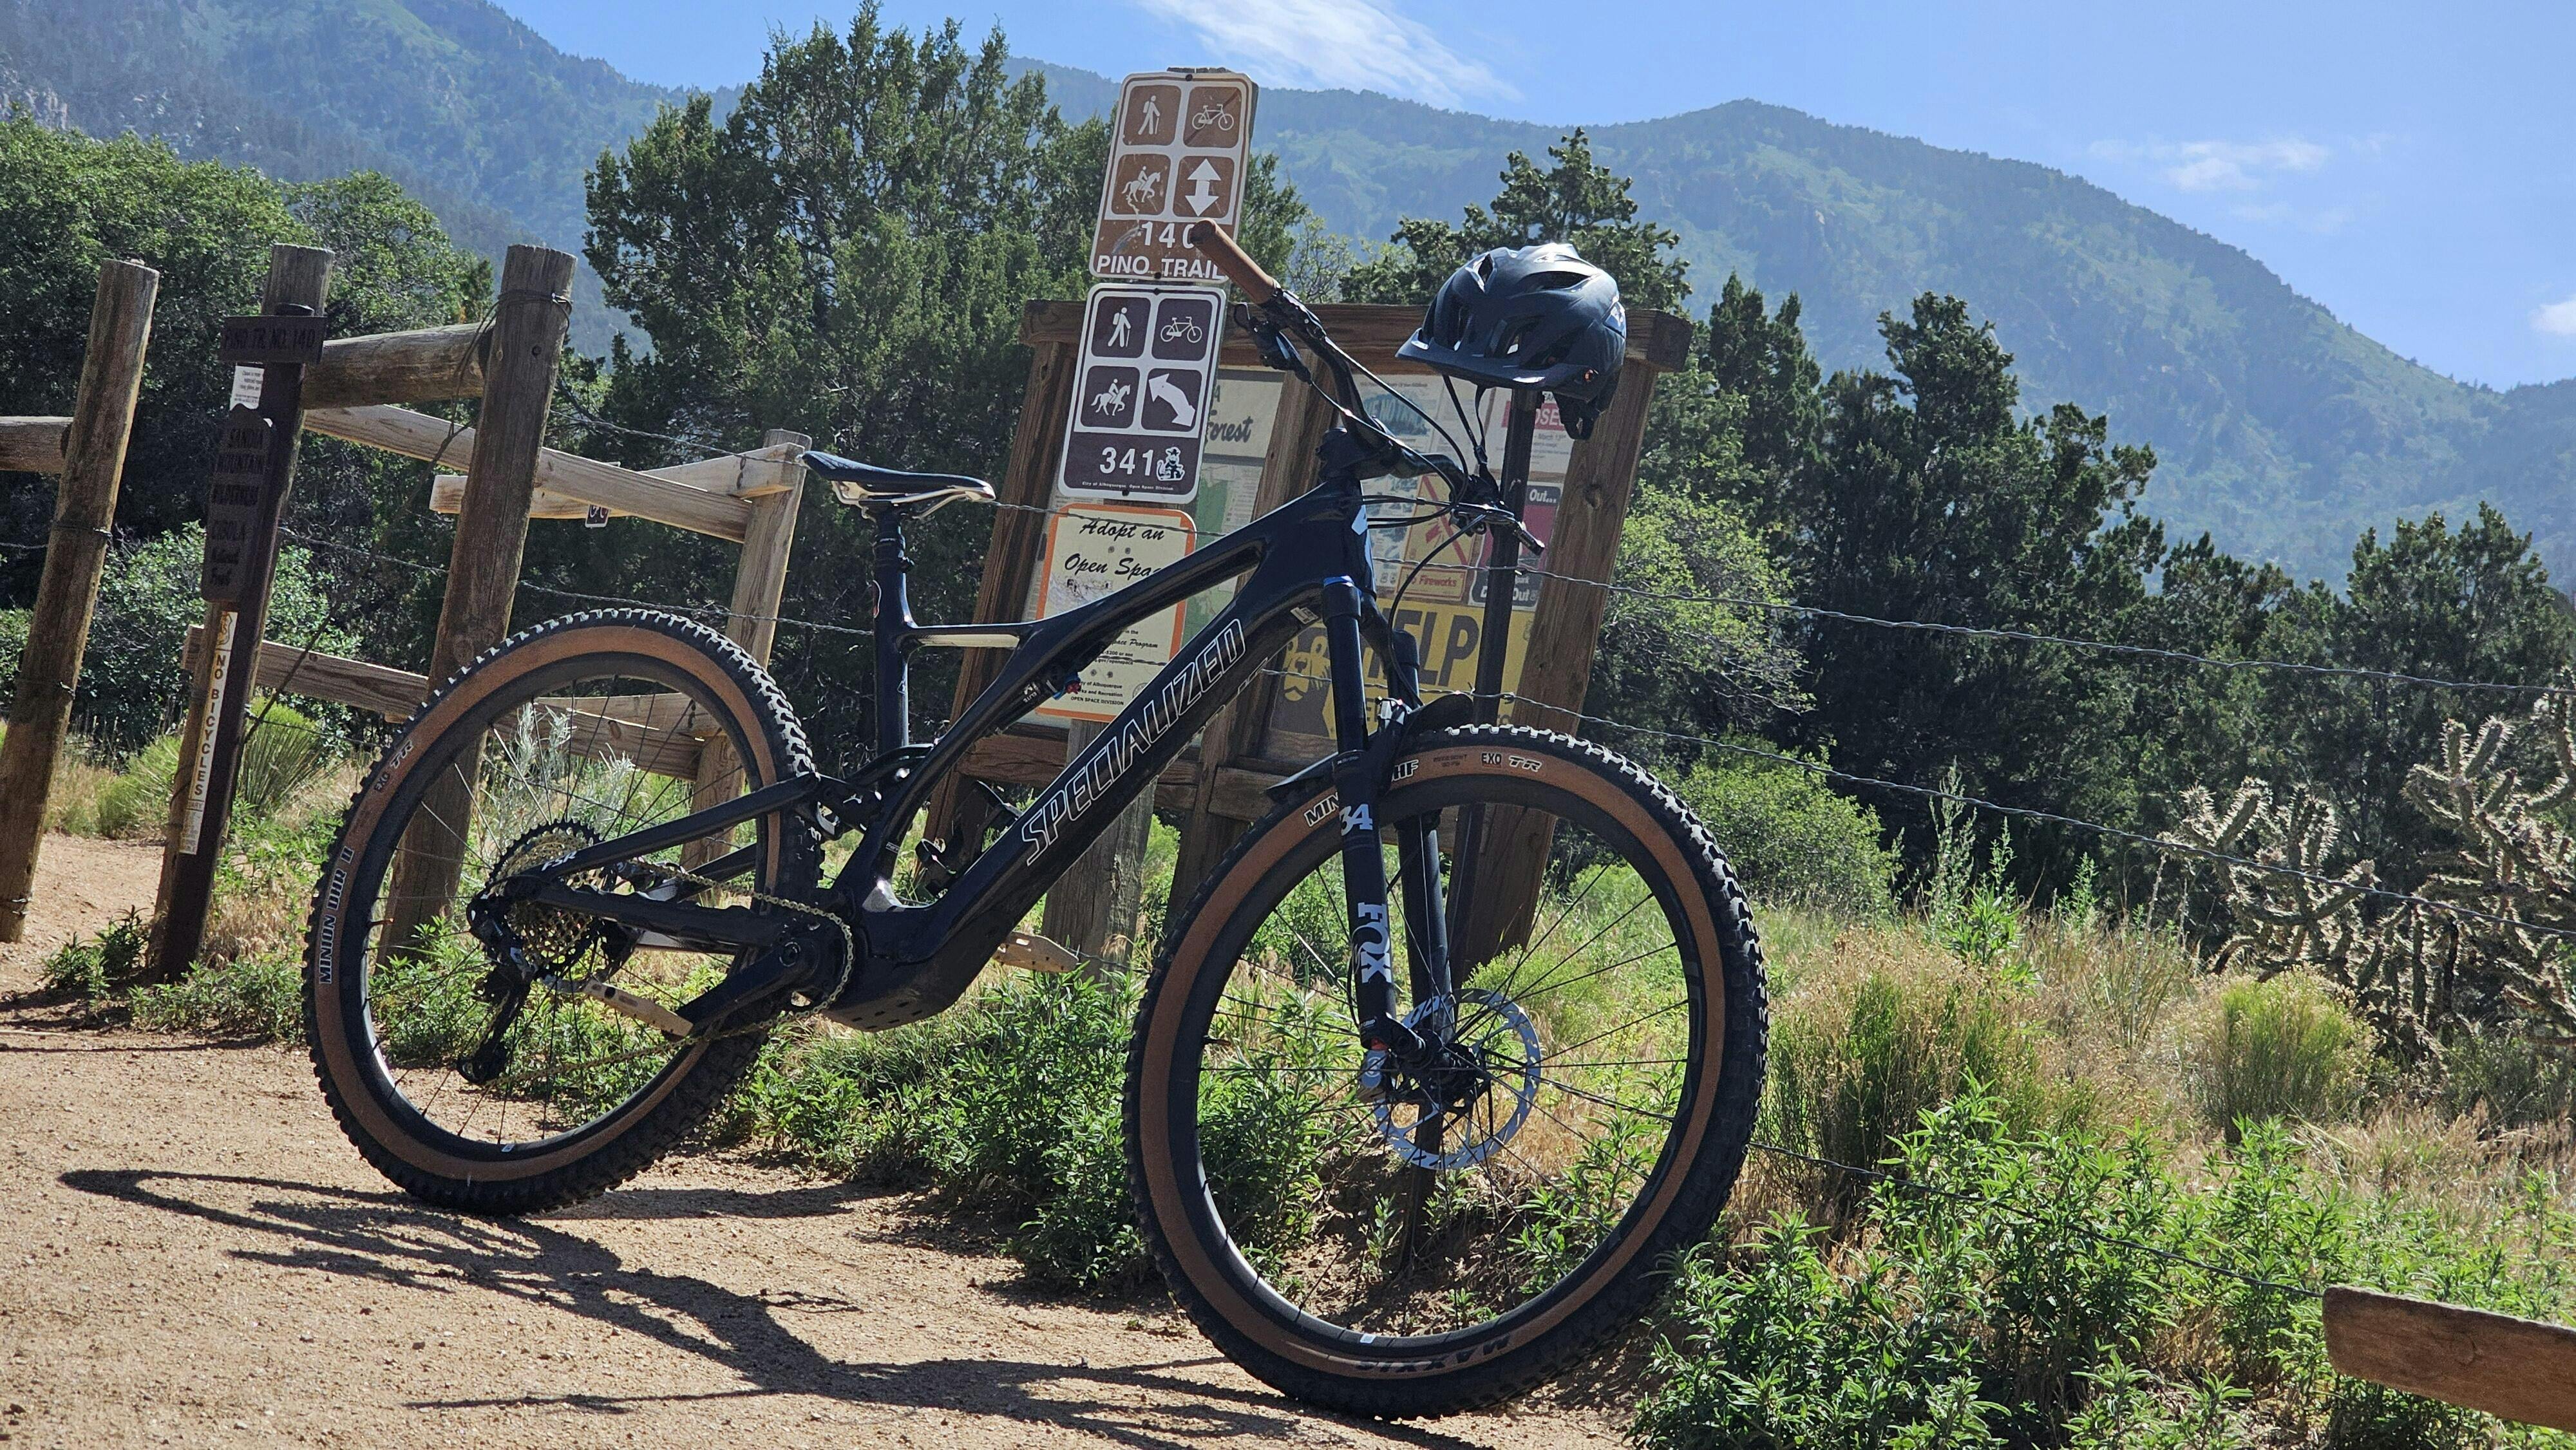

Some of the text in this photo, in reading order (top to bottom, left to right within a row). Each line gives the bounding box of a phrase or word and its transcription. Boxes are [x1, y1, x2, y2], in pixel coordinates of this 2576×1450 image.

[1096, 255, 1227, 280] PINO TRAIL
[1100, 447, 1154, 476] 341
[1079, 518, 1164, 541] Adopt an
[1064, 553, 1161, 580] Open Spa
[1130, 638, 1158, 649] Program
[194, 688, 220, 796] BICYCLES
[1021, 618, 1246, 867] SPECIALIZED
[1482, 752, 1502, 765] EXO
[1509, 755, 1542, 772] TR
[1339, 804, 1373, 836] 34
[541, 851, 577, 871] FSR
[327, 869, 347, 910] DHR
[319, 914, 336, 984] MINION
[1352, 901, 1392, 983] FOX
